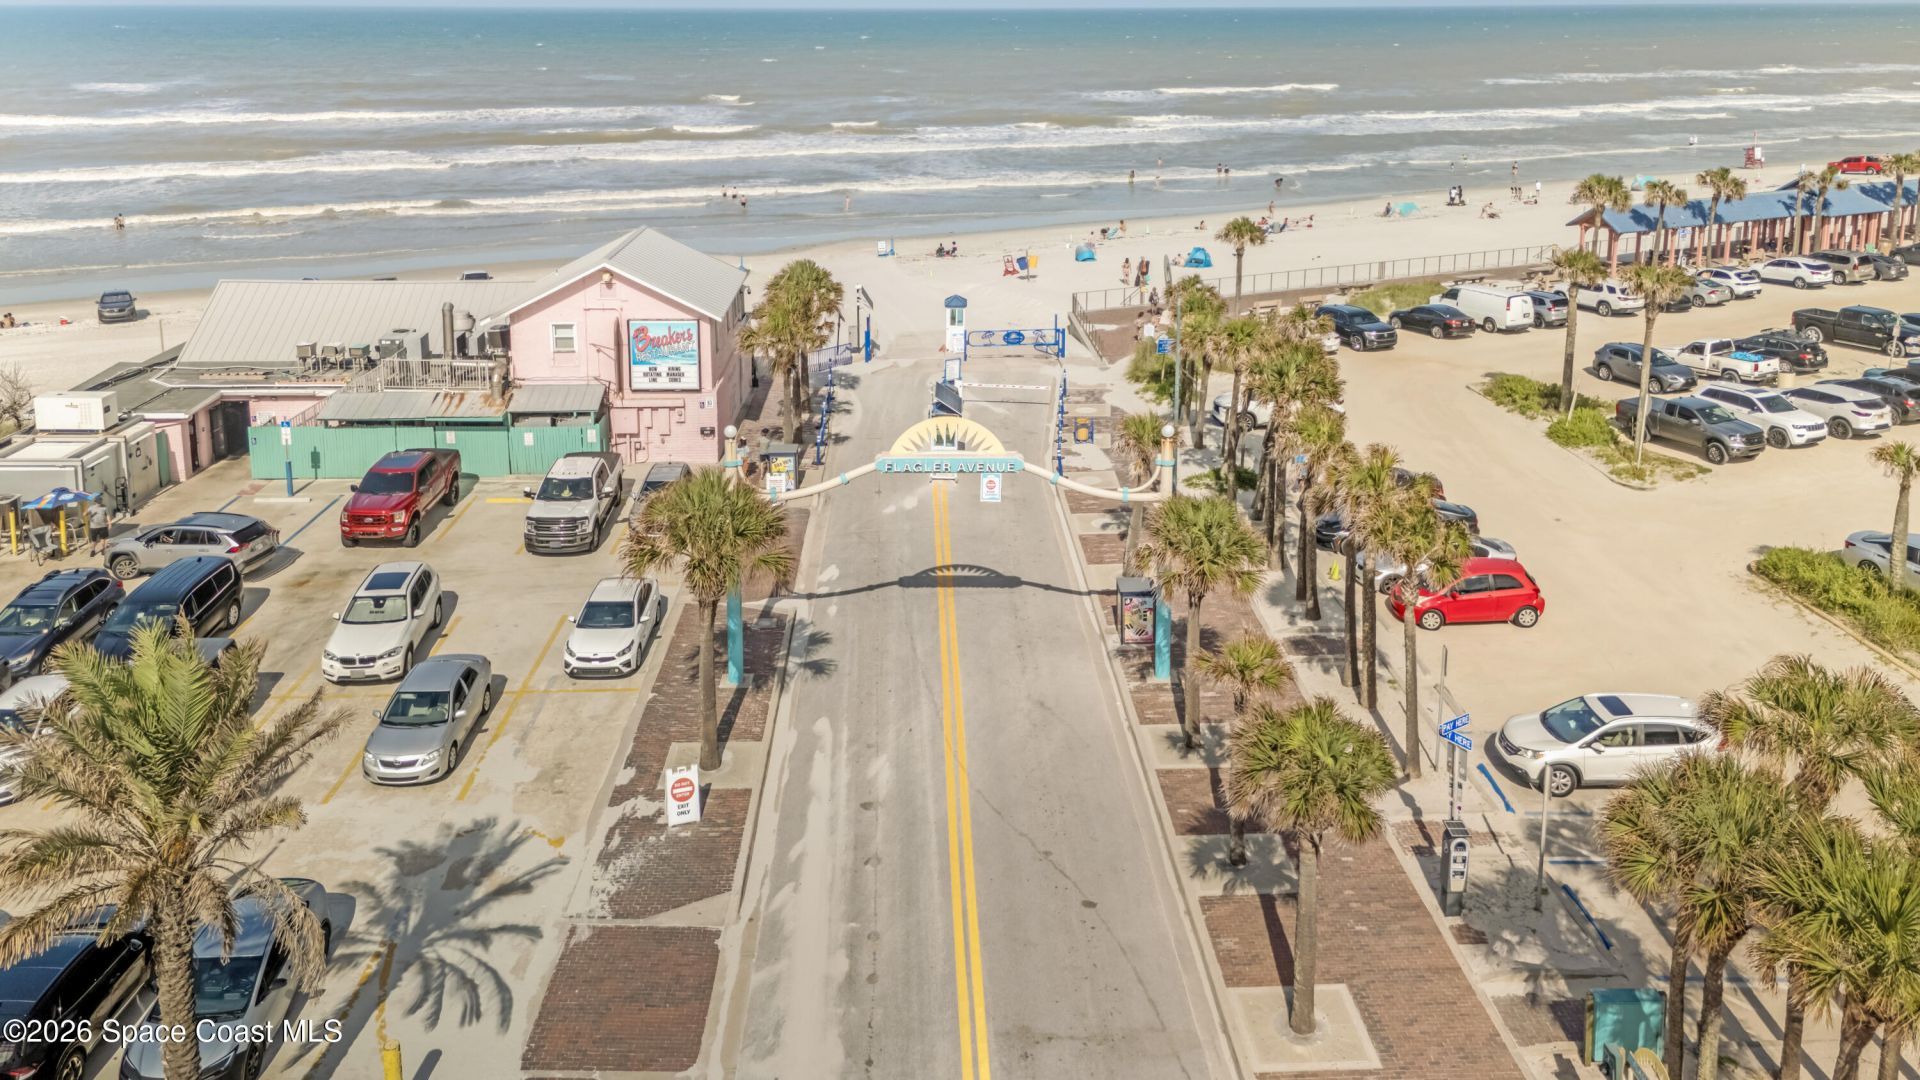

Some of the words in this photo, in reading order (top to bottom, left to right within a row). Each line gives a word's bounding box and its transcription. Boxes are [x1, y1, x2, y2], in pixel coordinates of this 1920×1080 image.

[633, 325, 693, 352] Breakers
[636, 340, 695, 362] RESTAURANT
[885, 463, 951, 472] FLAGLER
[957, 463, 1016, 472] AVENUE
[1442, 721, 1453, 734] PAY
[1455, 715, 1469, 728] HERE
[1454, 734, 1471, 749] HERE
